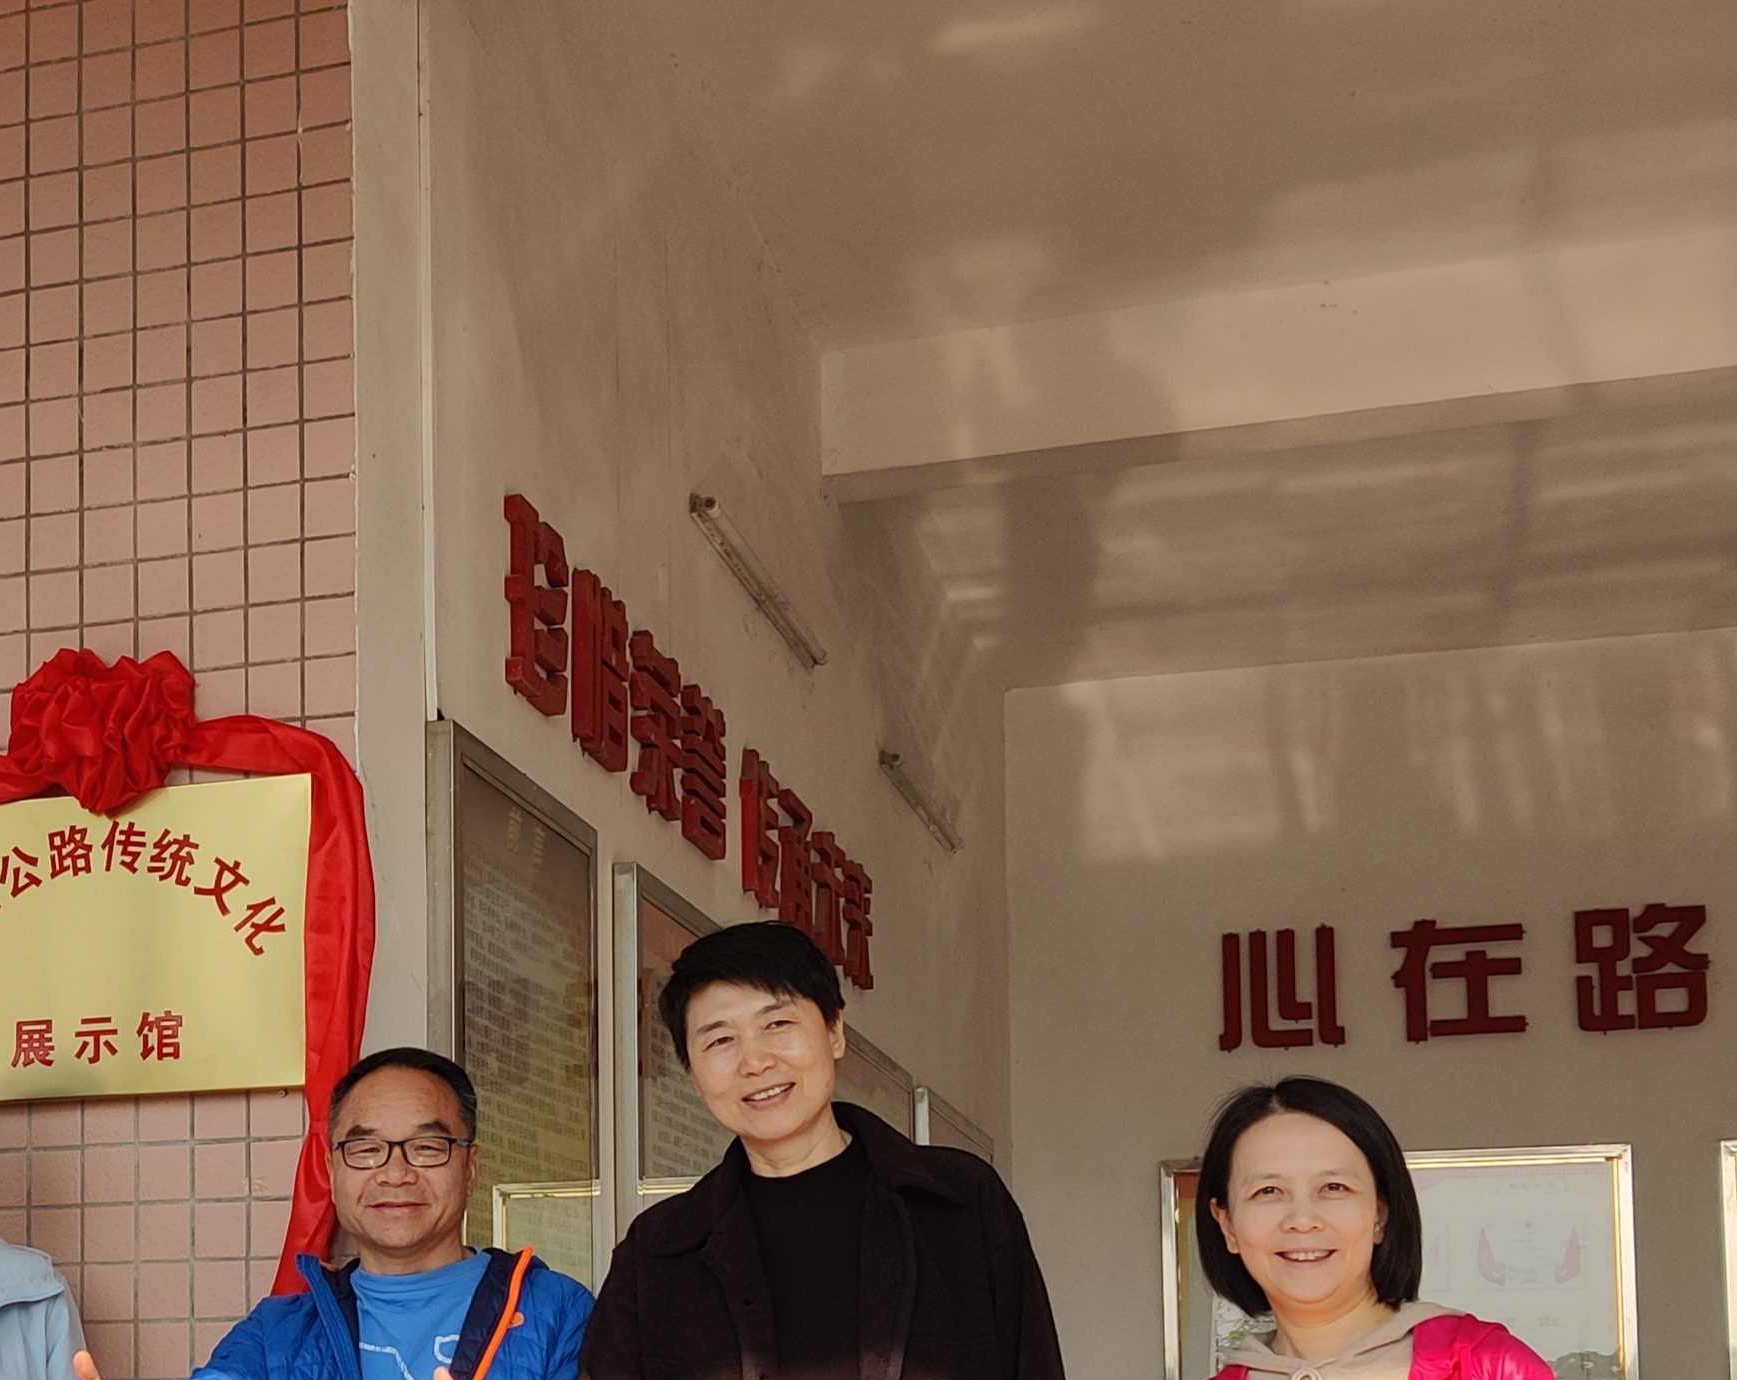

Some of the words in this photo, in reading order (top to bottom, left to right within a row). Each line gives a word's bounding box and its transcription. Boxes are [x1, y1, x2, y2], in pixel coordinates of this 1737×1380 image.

[1218, 902, 1710, 1052] 心在路
[10, 1010, 184, 1069] 展示馆
